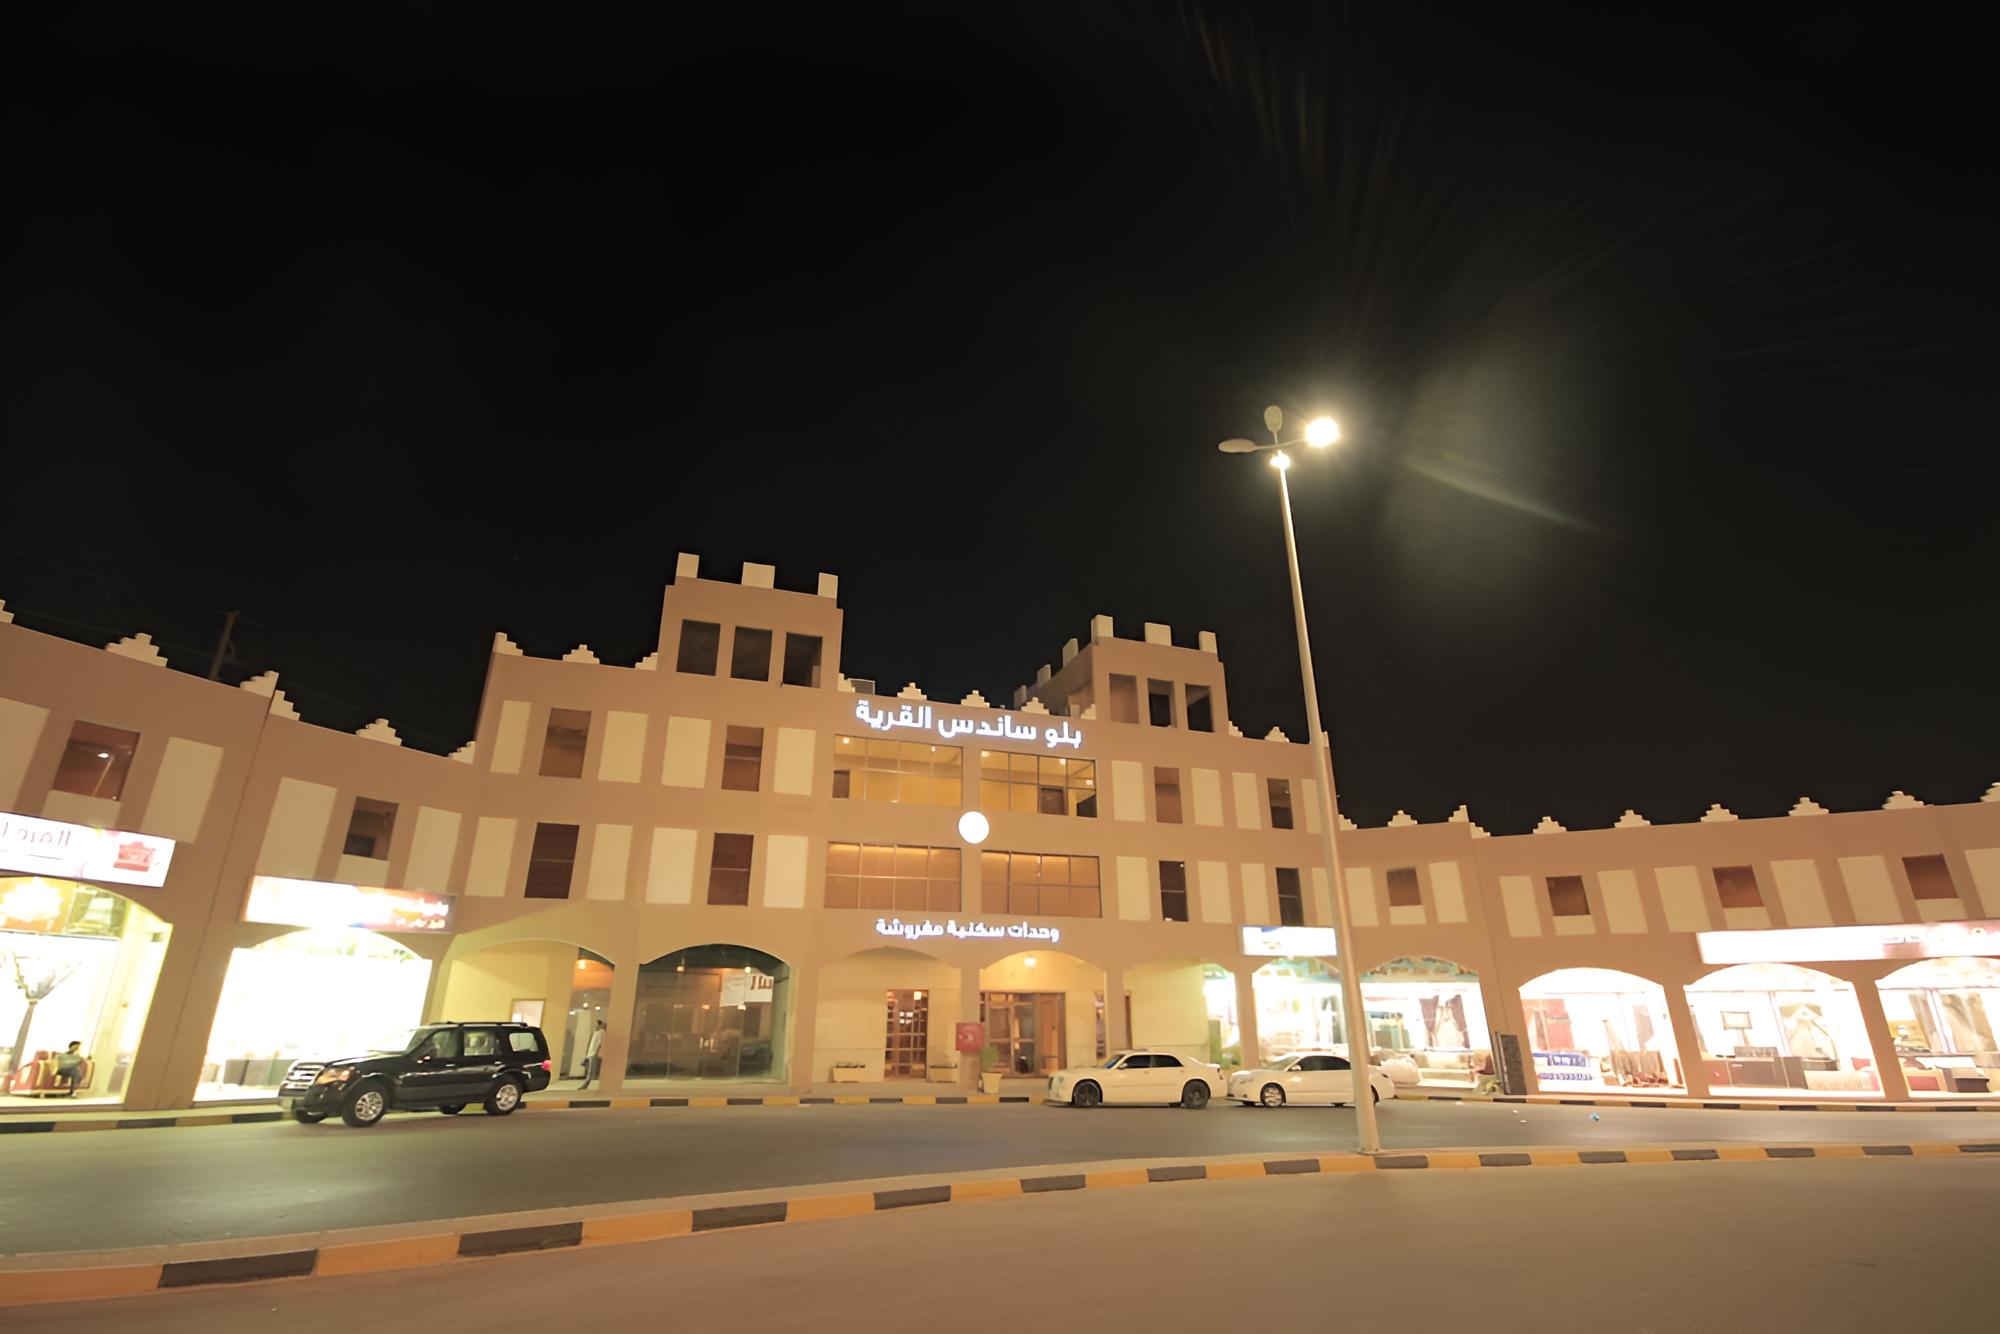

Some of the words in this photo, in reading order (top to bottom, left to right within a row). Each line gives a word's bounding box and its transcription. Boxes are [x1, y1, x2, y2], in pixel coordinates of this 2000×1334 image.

[855, 699, 932, 731] القرية
[937, 715, 1037, 738] ساندس
[1044, 721, 1082, 749] بلو
[875, 918, 944, 940] مفروشة
[946, 919, 1005, 940] سكنية
[1007, 921, 1060, 943] وحدات
